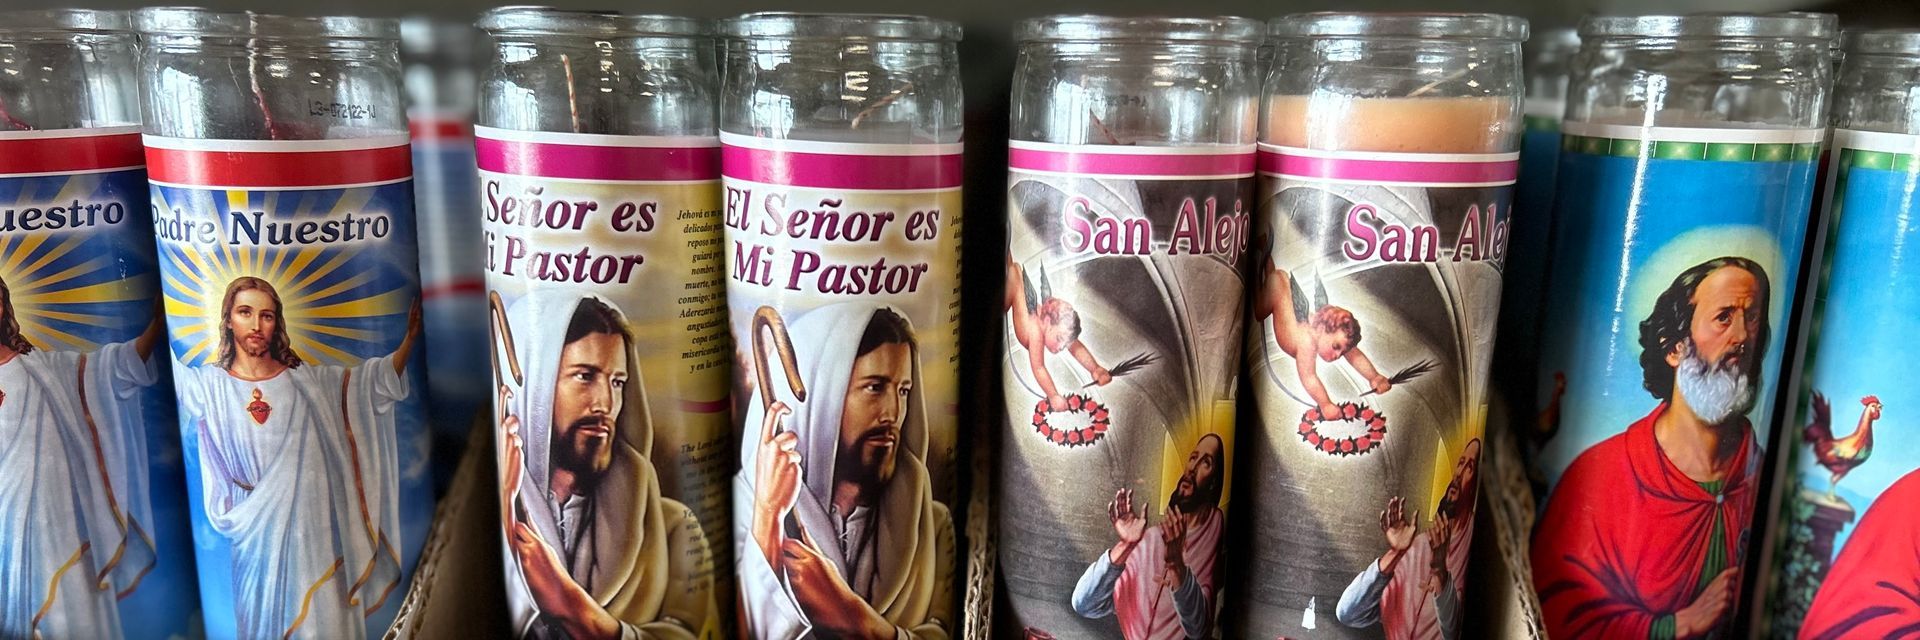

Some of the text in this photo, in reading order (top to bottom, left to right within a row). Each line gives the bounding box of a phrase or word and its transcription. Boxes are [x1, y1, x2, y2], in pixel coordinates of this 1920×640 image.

[0, 199, 124, 232] uestro
[151, 204, 390, 246] Padre Nuestro
[486, 180, 657, 232] Señor es
[725, 185, 939, 242] El Señor es
[1062, 197, 1249, 266] San Alejo
[503, 236, 643, 284] Pastor
[1344, 203, 1512, 271] San Alej
[733, 240, 928, 294] Mi Pastor
